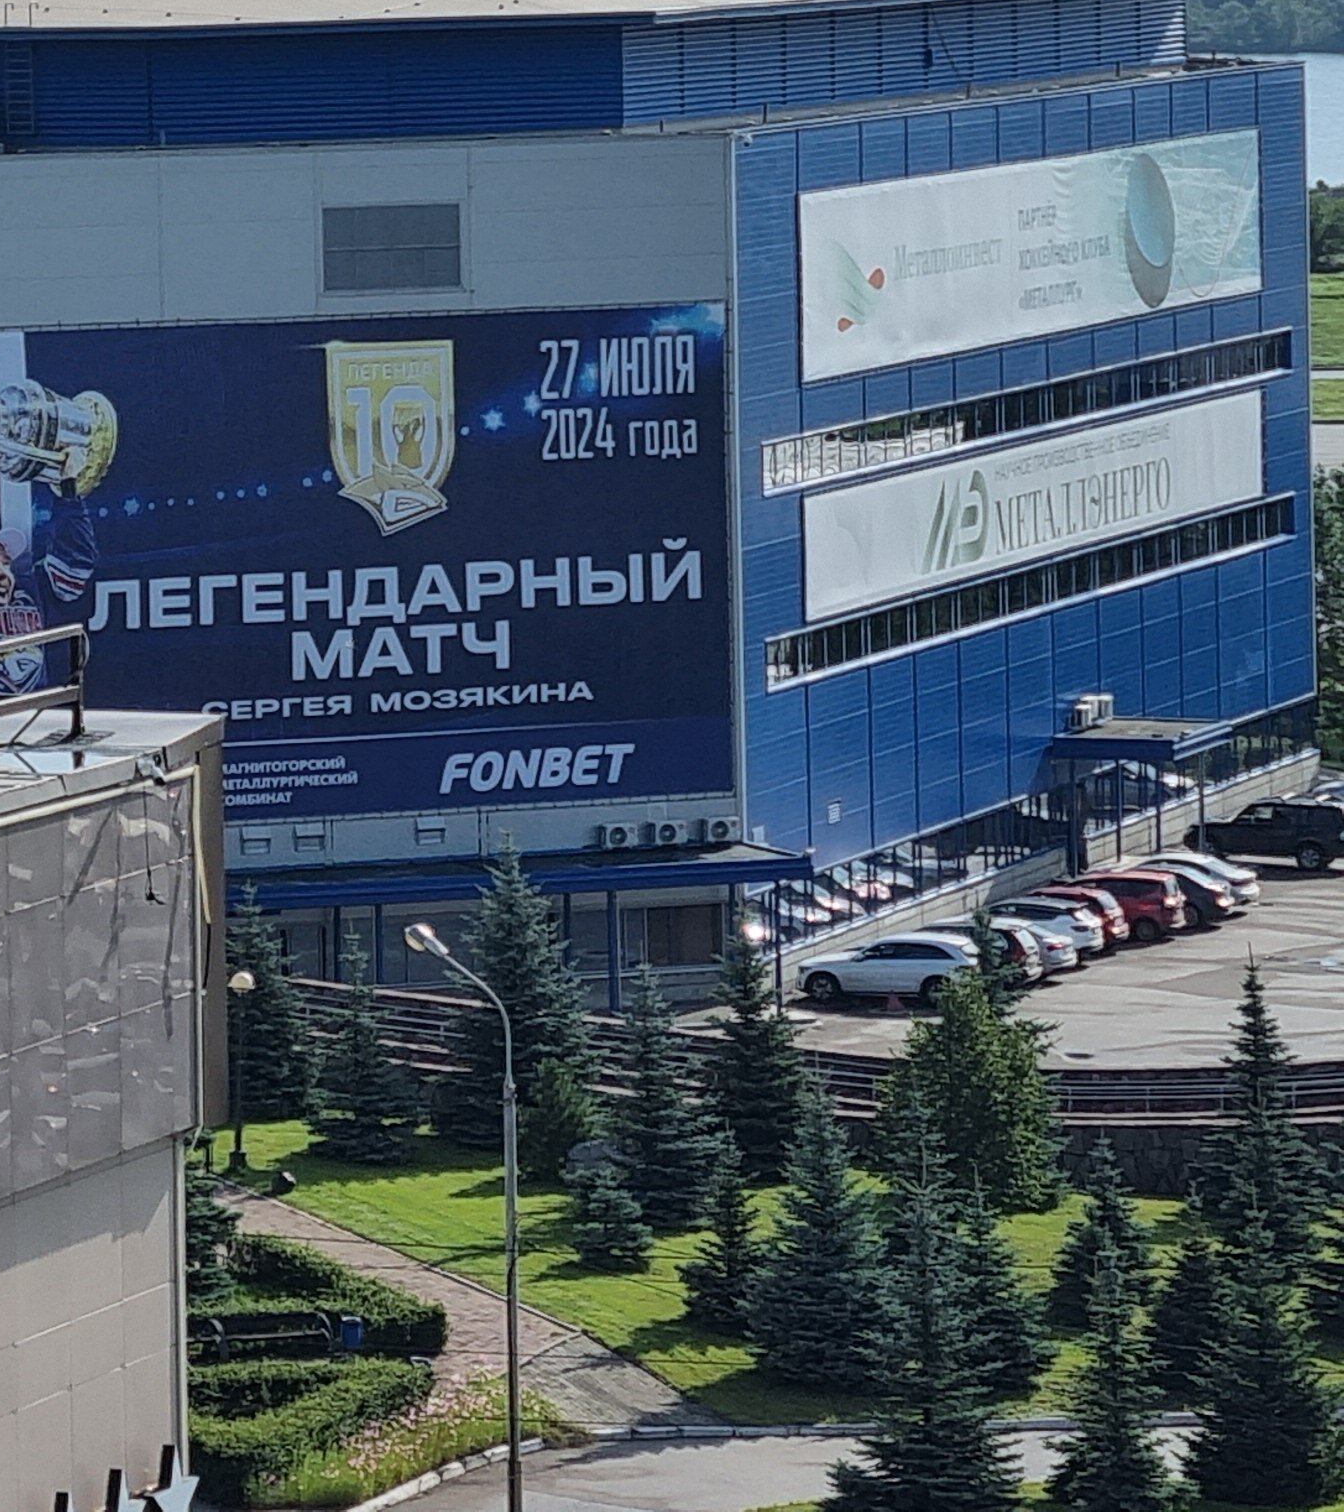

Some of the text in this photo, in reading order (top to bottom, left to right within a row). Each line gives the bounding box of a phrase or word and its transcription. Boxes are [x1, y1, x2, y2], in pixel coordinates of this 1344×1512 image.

[348, 360, 434, 381] ЛЕГЕНДА
[540, 335, 695, 400] 27 ИЮЛЯ
[346, 386, 436, 478] 10
[541, 406, 698, 461] 2024 года
[995, 457, 1171, 555] МЕТАЛЛЭНЕРГО
[89, 537, 703, 632] ЛЕГЕНДАРНЫЙ
[291, 619, 510, 682] МАТЧ
[201, 680, 594, 721] СЕРГЕЯ МОЗЯКИНА
[439, 743, 635, 794] FONBET
[223, 791, 293, 807] ОМБИНАТ
